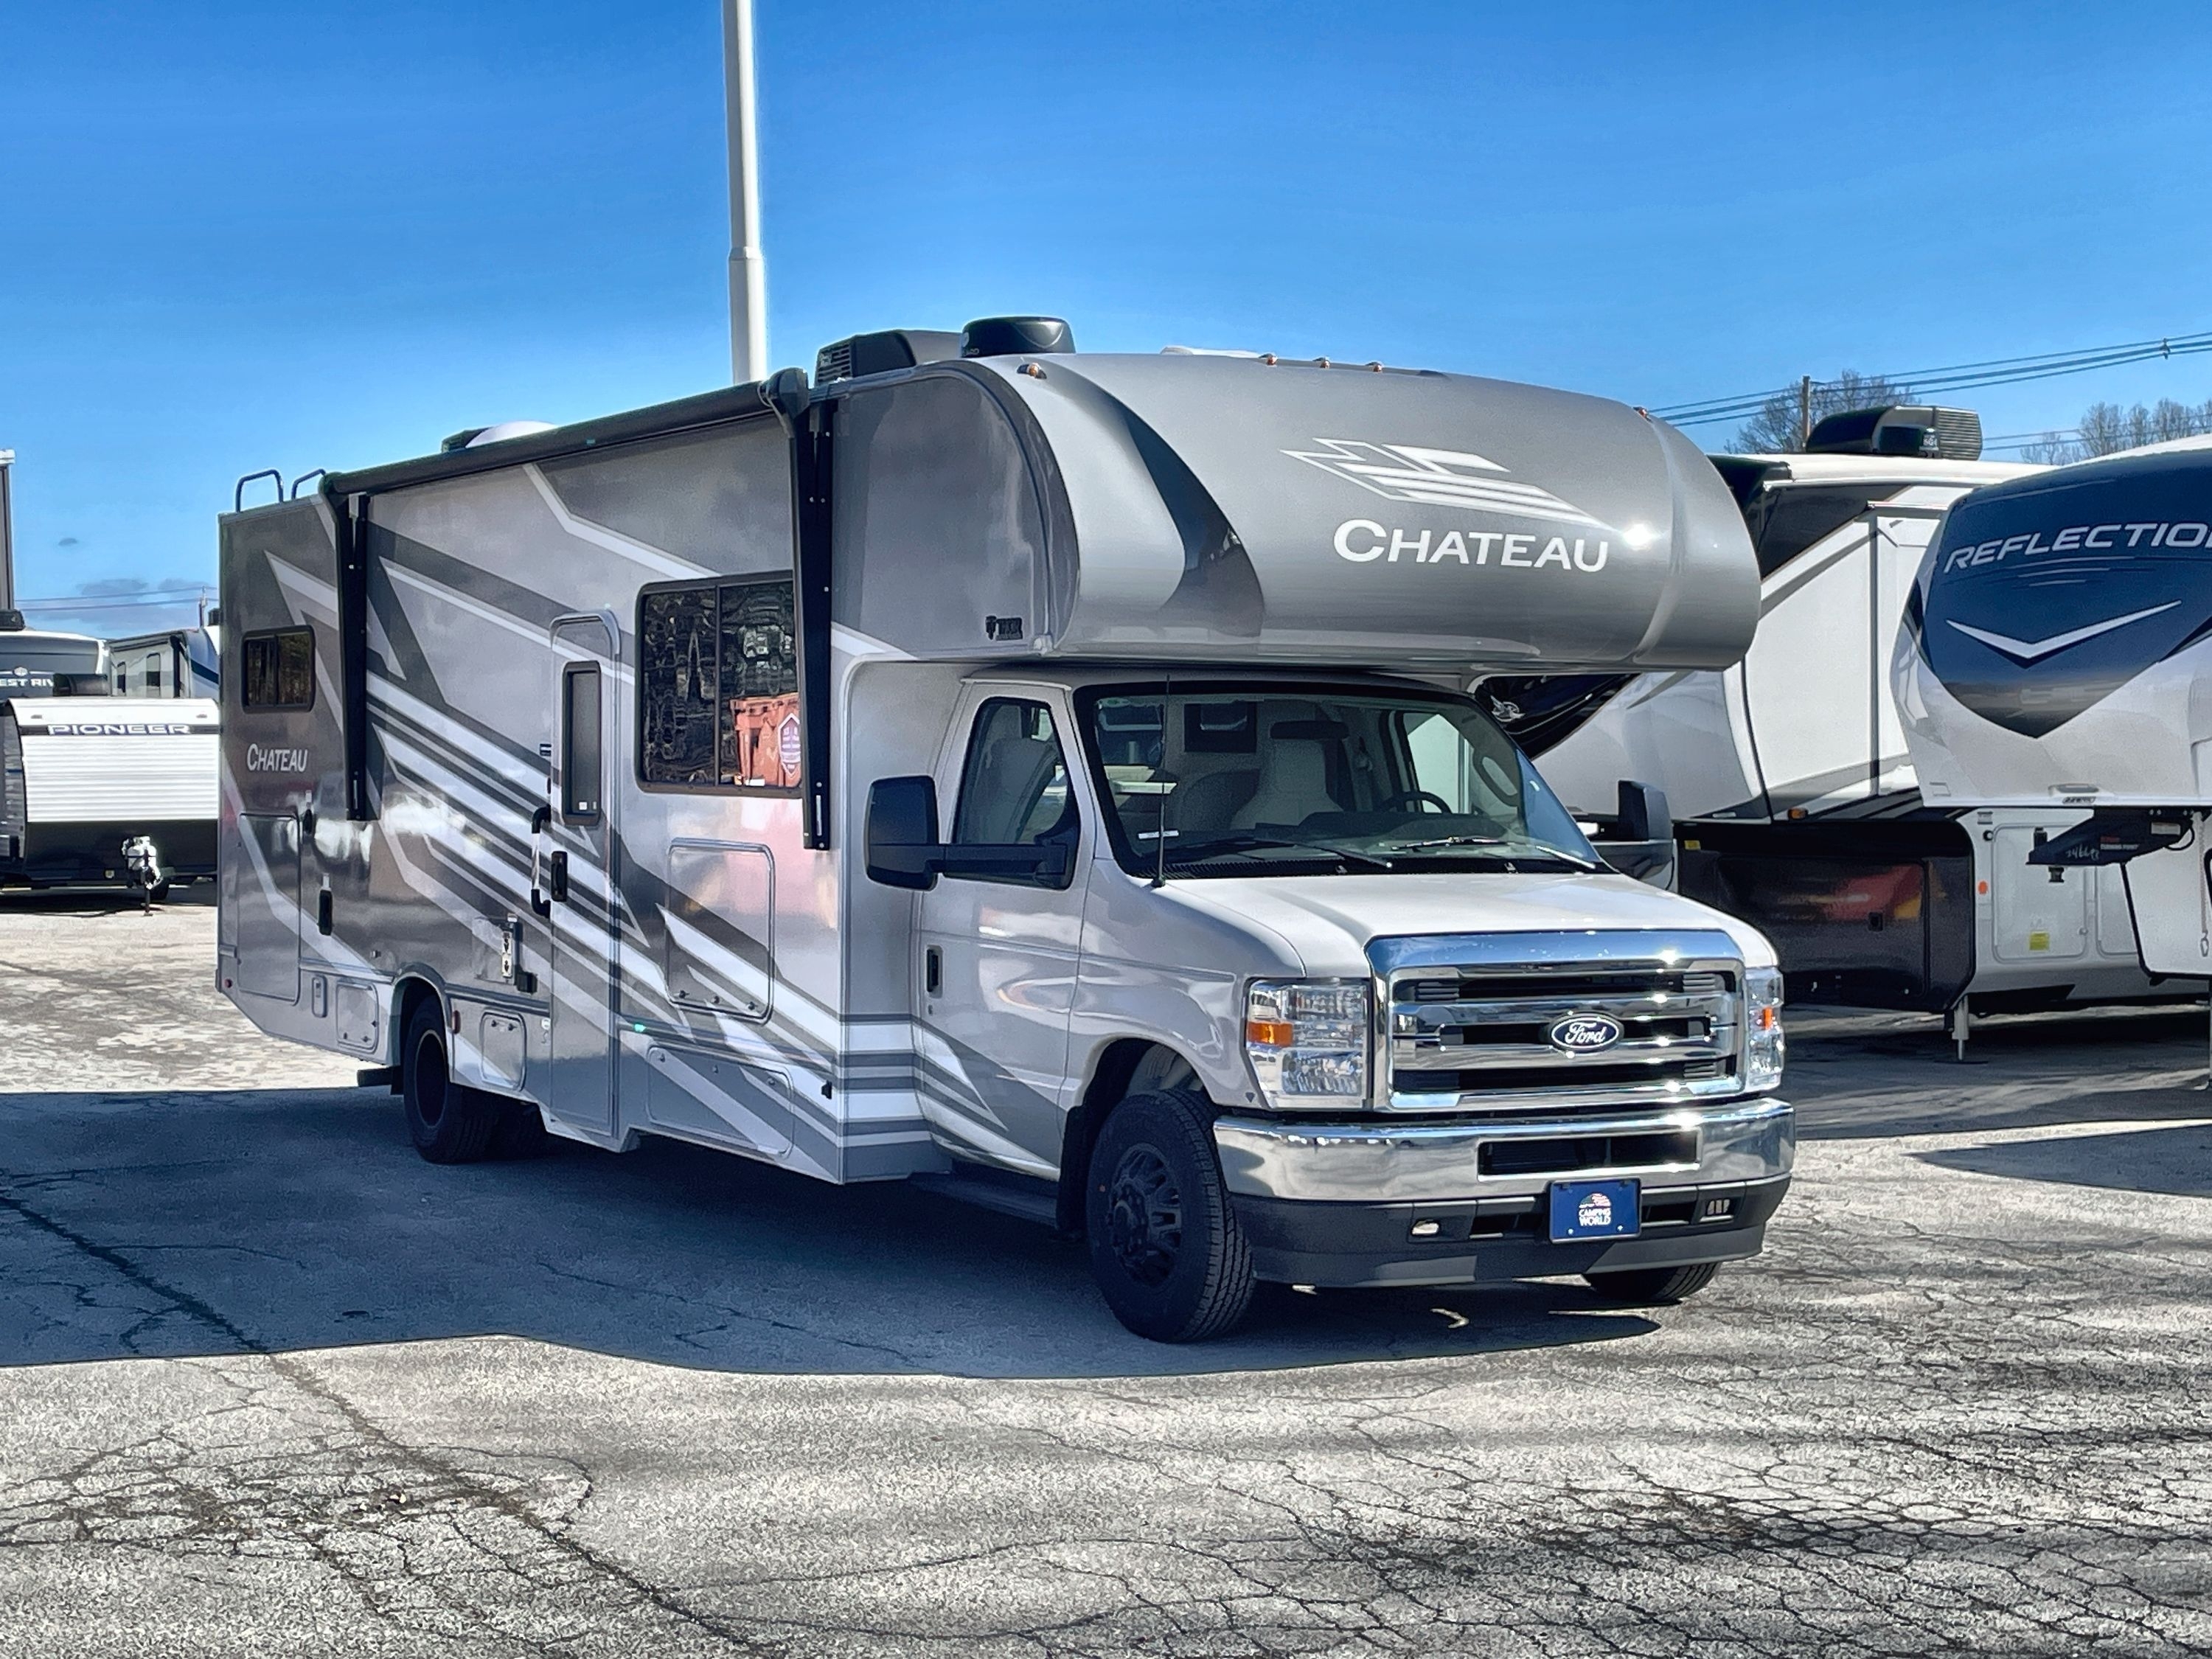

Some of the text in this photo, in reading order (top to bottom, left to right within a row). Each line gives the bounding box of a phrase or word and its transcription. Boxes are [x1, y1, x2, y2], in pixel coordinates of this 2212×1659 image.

[1333, 518, 1609, 573] CHATEAU
[1943, 523, 2212, 574] REFLECTIO
[47, 724, 191, 735] PIONEER
[246, 742, 308, 773] CHATEAU
[1564, 1022, 1607, 1044] Ford
[1578, 1215, 1612, 1227] WORLD
